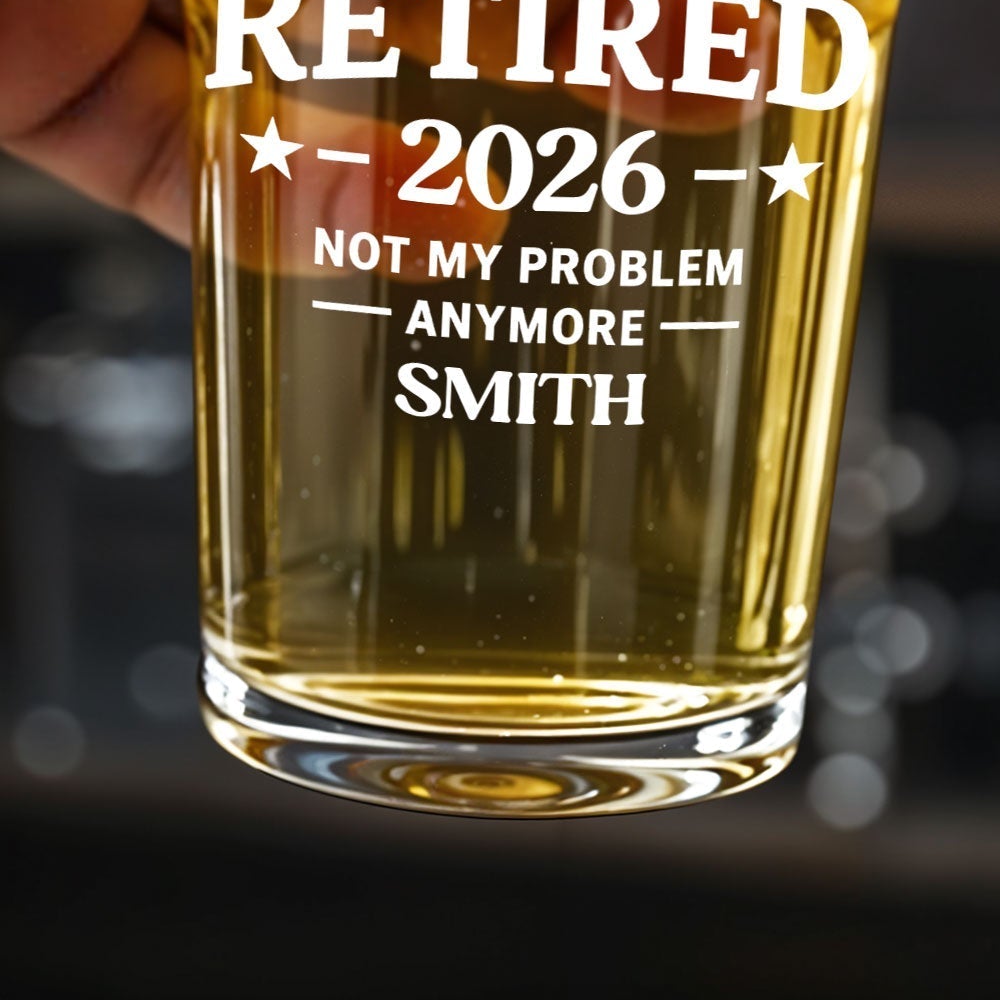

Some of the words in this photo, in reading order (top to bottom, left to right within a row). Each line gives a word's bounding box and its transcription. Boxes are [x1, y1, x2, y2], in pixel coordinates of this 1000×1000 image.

[398, 118, 665, 215] 2026
[313, 227, 410, 274] NOT
[428, 240, 502, 282] MY
[519, 247, 744, 287] PROBLEM
[405, 300, 645, 346] ANYMORE
[394, 362, 646, 426] SMITH
